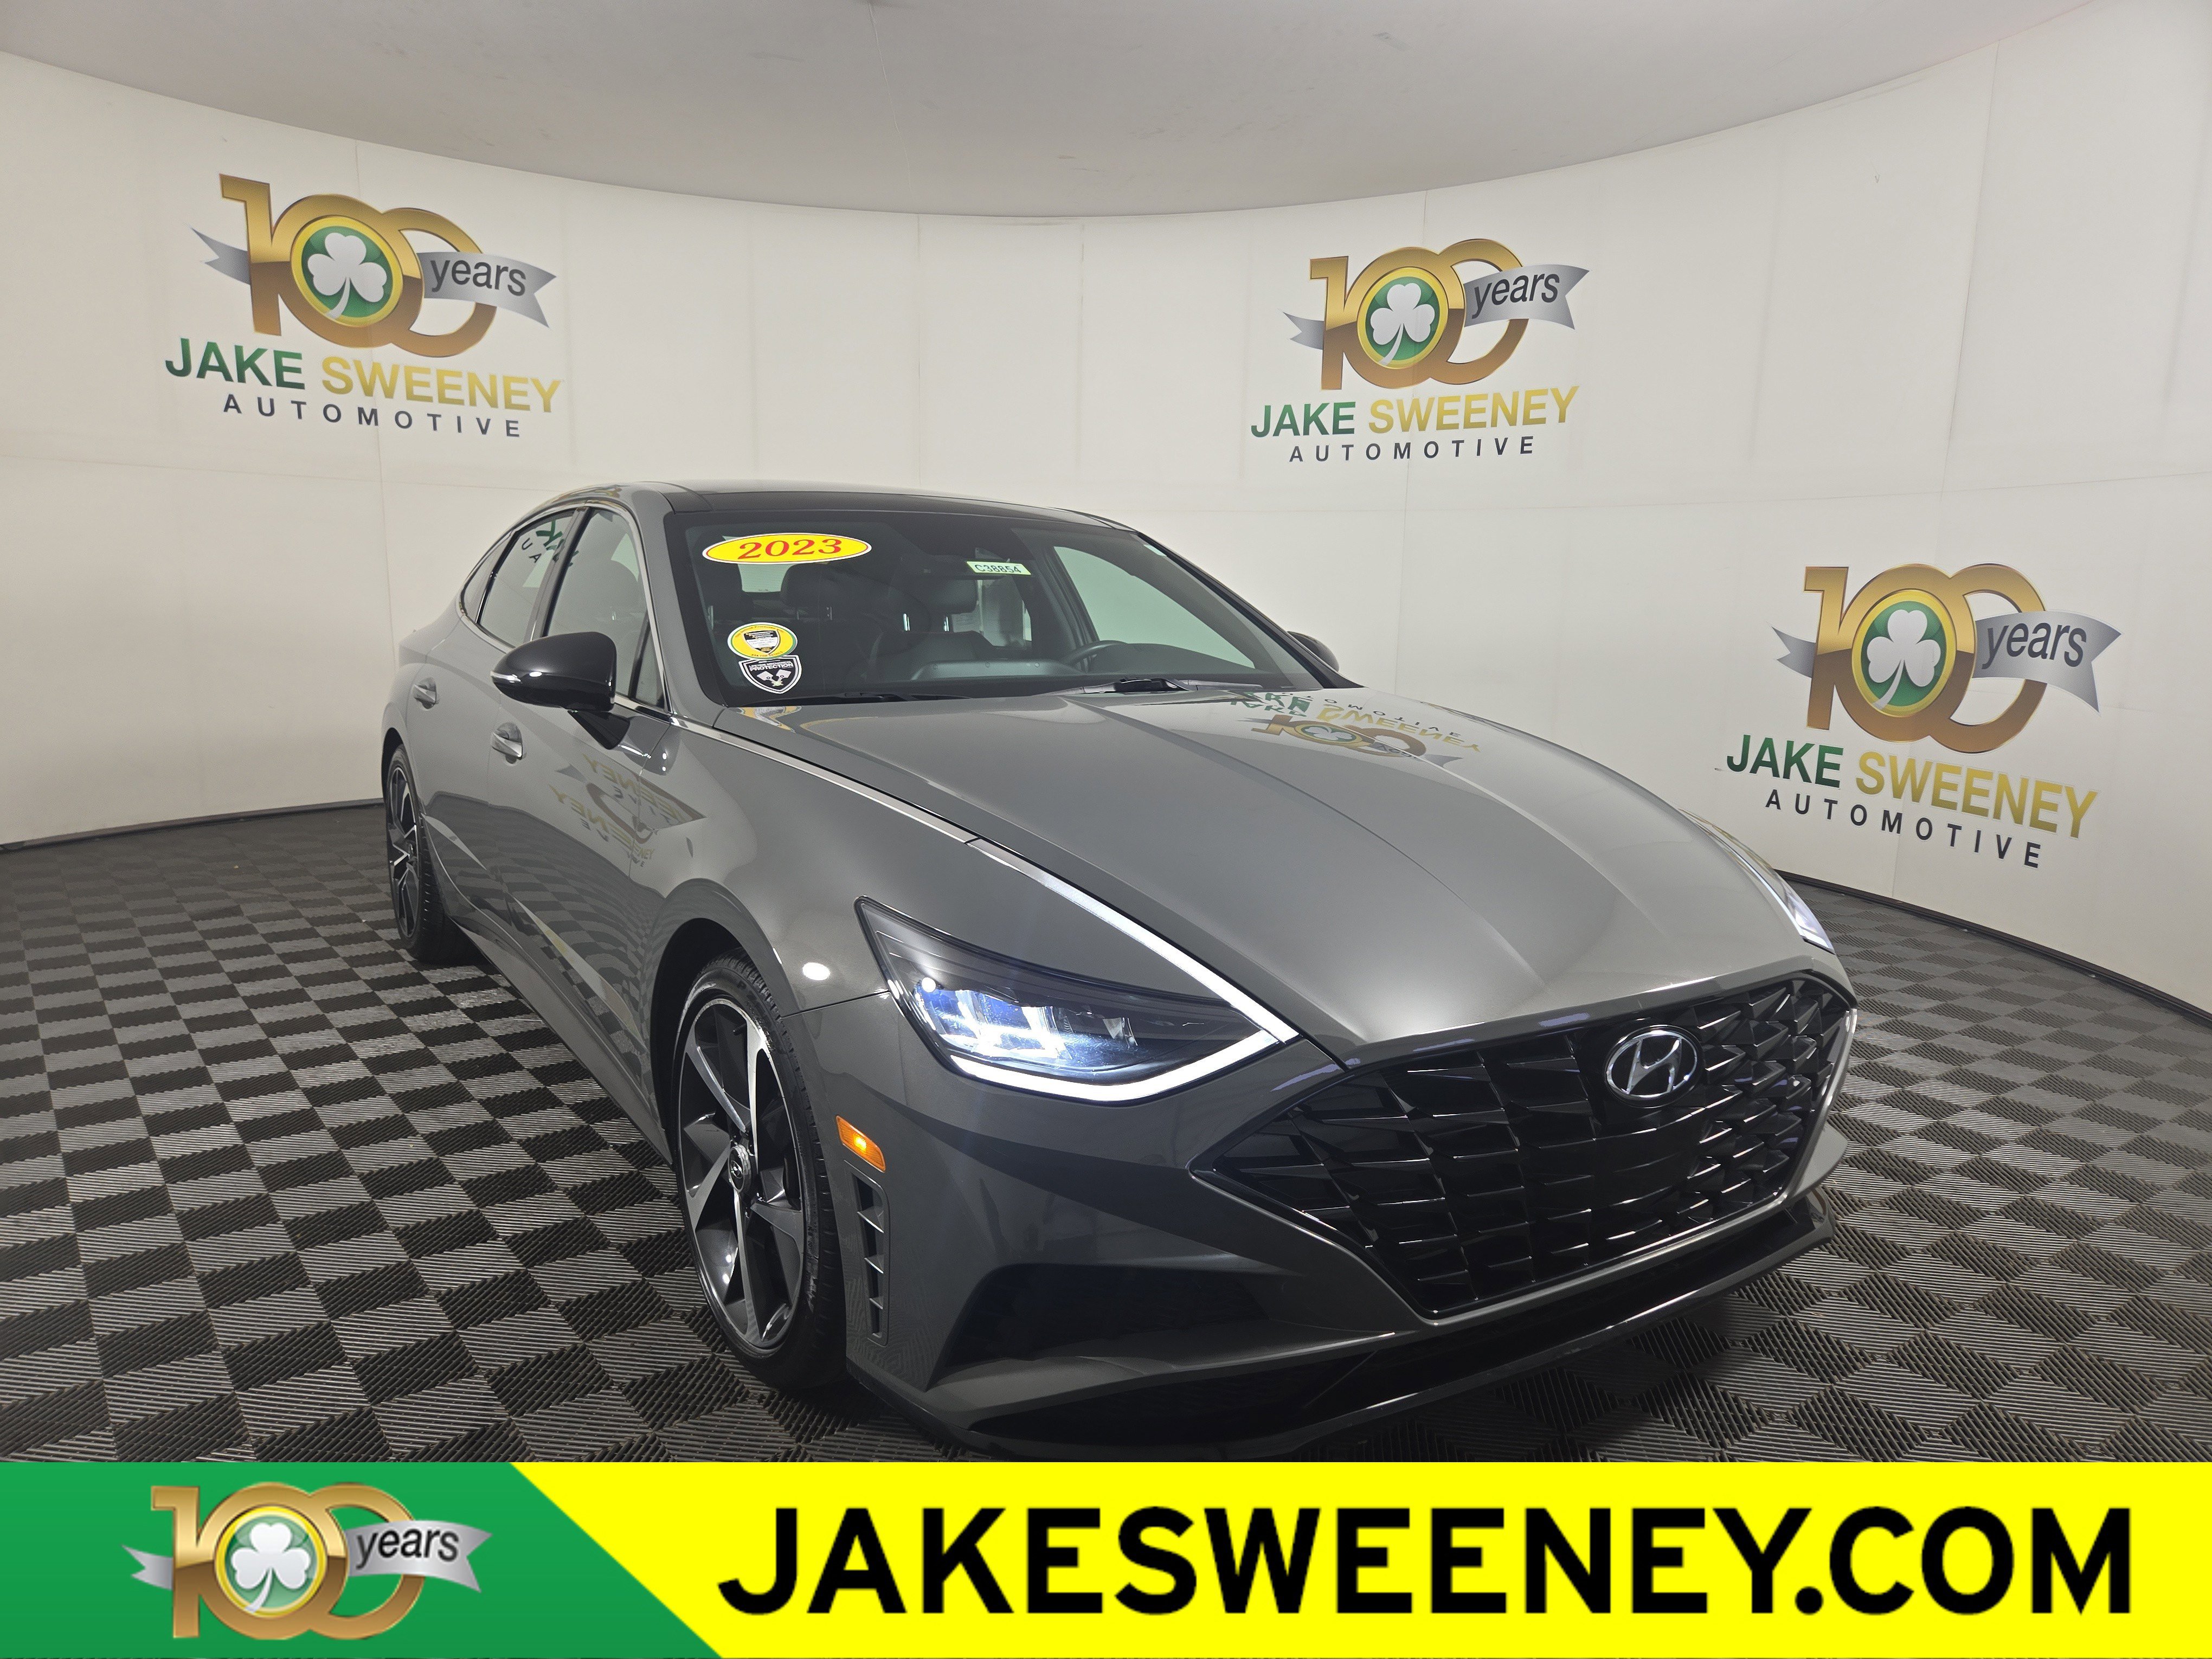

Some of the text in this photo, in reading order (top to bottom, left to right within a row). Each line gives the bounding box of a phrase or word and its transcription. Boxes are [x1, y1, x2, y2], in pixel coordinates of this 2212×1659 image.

[430, 259, 527, 297] years
[1471, 272, 1560, 319] years
[165, 337, 562, 413] JAKE SWEENEY
[223, 393, 520, 438] AUTOMOTIVE
[1250, 385, 1580, 438] JAKE SWEENEY
[1289, 435, 1534, 462] AUTOMOTIVE
[737, 539, 842, 560] 2023
[974, 564, 1021, 573] C38854
[749, 663, 794, 672] PROTECTION
[1980, 622, 2087, 670] years
[1726, 734, 2099, 839] JAKE SWEENEY
[1765, 788, 2041, 869] AUTOMOTIVE
